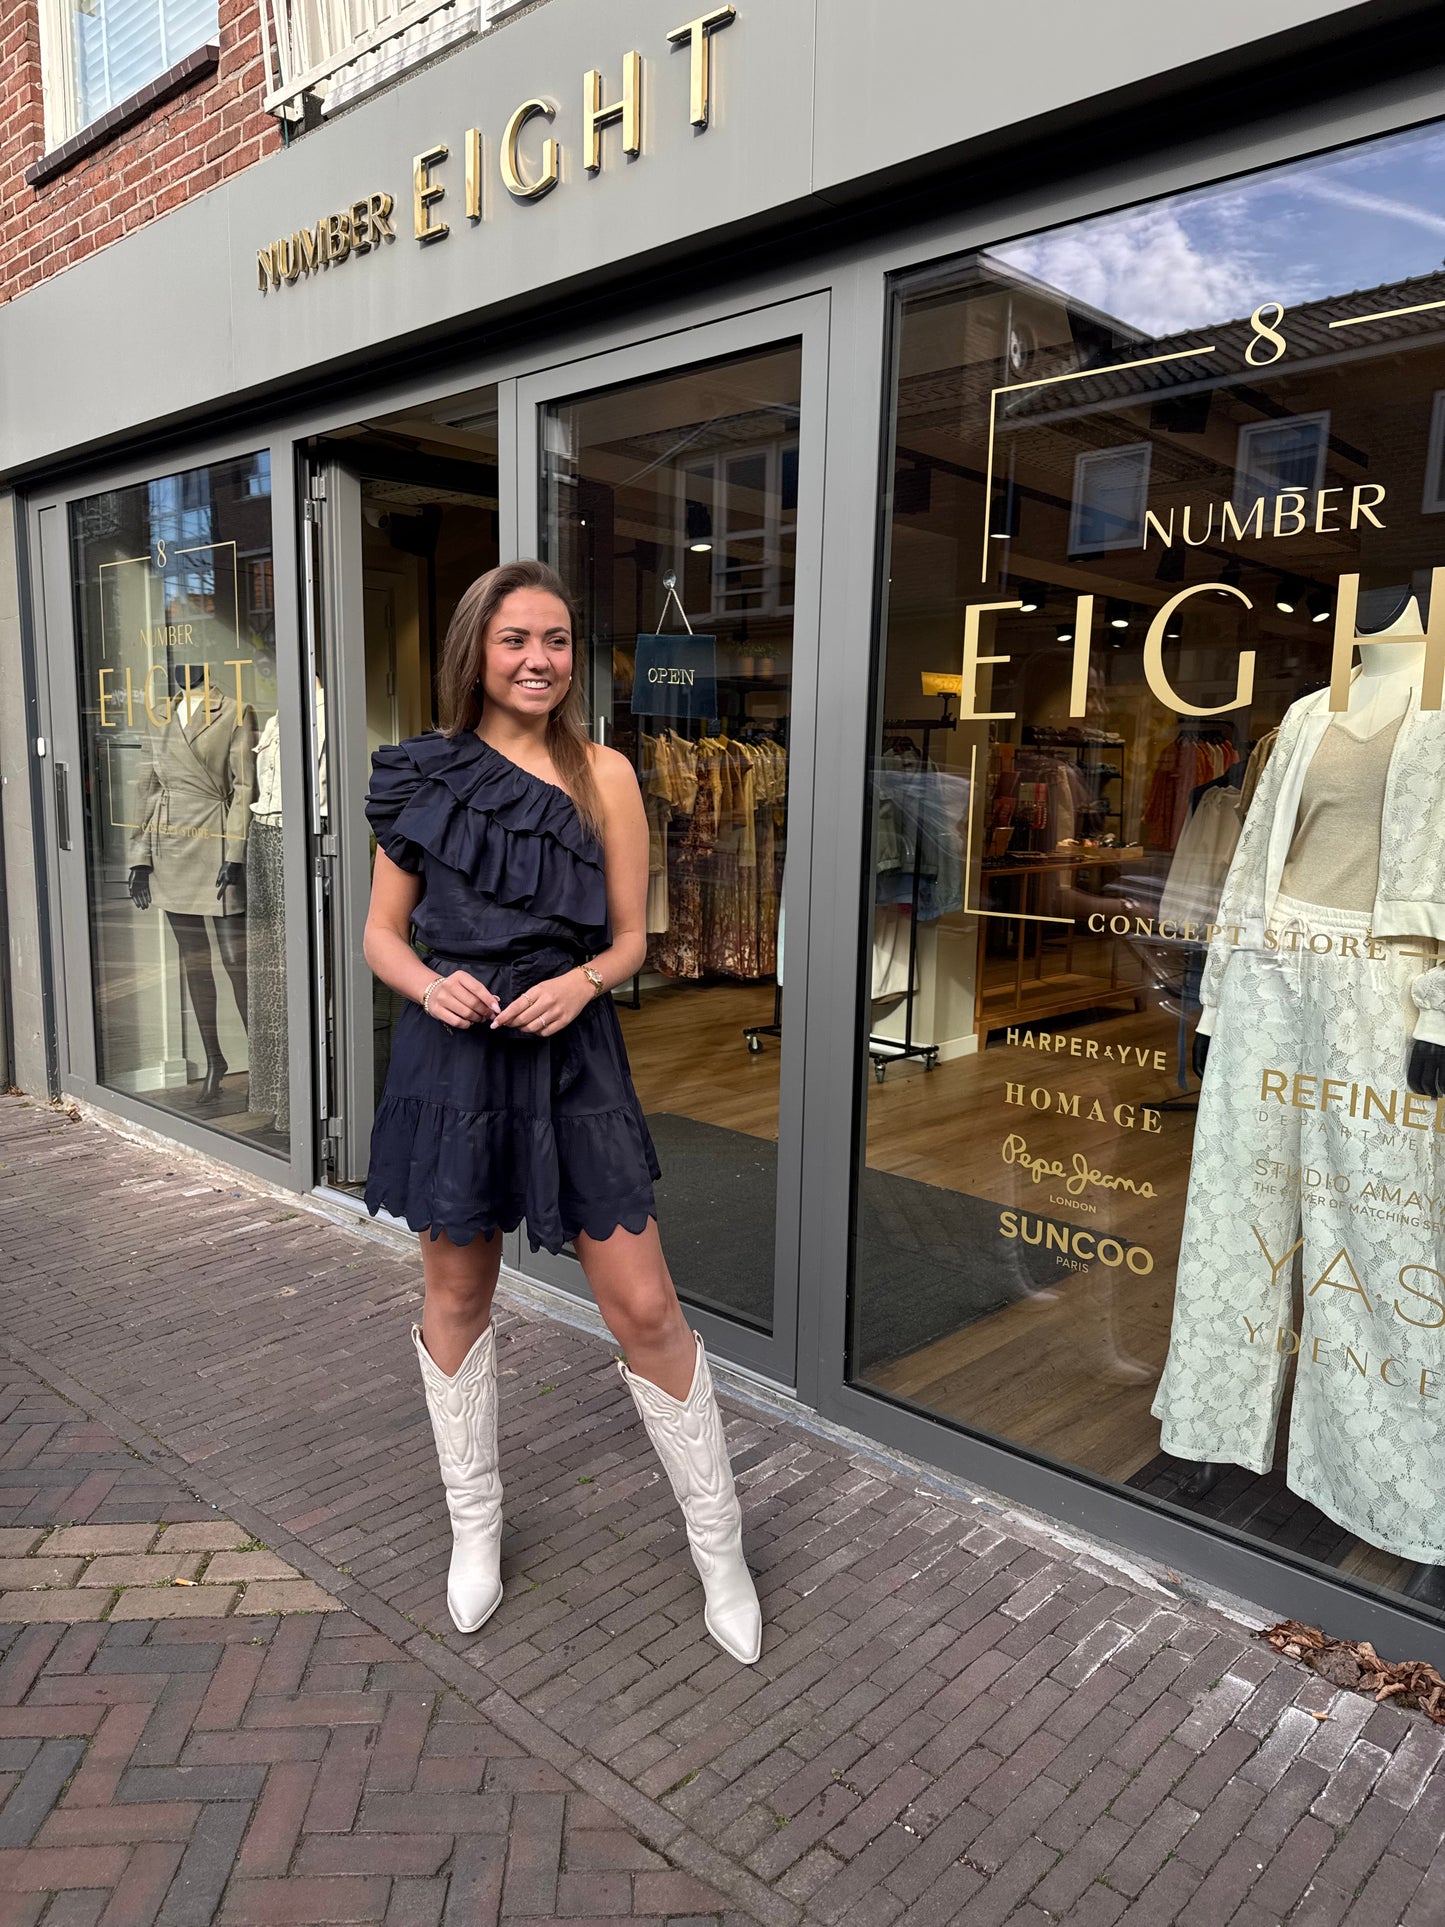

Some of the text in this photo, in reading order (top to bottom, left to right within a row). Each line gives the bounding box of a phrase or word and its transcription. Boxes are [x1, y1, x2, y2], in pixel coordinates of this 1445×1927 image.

[255, 3, 737, 293] NUMBER EIGHT
[1244, 302, 1288, 366] 8
[1142, 484, 1387, 551] NUMBER
[155, 539, 168, 568] 8
[140, 623, 194, 650] NUMBER
[959, 566, 1445, 720] EIGH
[98, 660, 253, 728] EIGHT
[647, 667, 696, 686] OPEN
[1087, 912, 1388, 962] CONCEPT STORE
[1004, 1081, 1163, 1134] HOMAGE
[1002, 1133, 1158, 1199] Pepe Jeans
[1254, 1158, 1351, 1194] STUDIO
[1049, 1194, 1097, 1214] LONDON
[1254, 1181, 1277, 1195] THE
[1329, 1198, 1347, 1210] OF
[1349, 1203, 1420, 1228] MATCHING
[999, 1211, 1154, 1276] SUNCOO
[1056, 1255, 1089, 1274] PARIS
[1243, 1315, 1442, 1401] YDENCE
